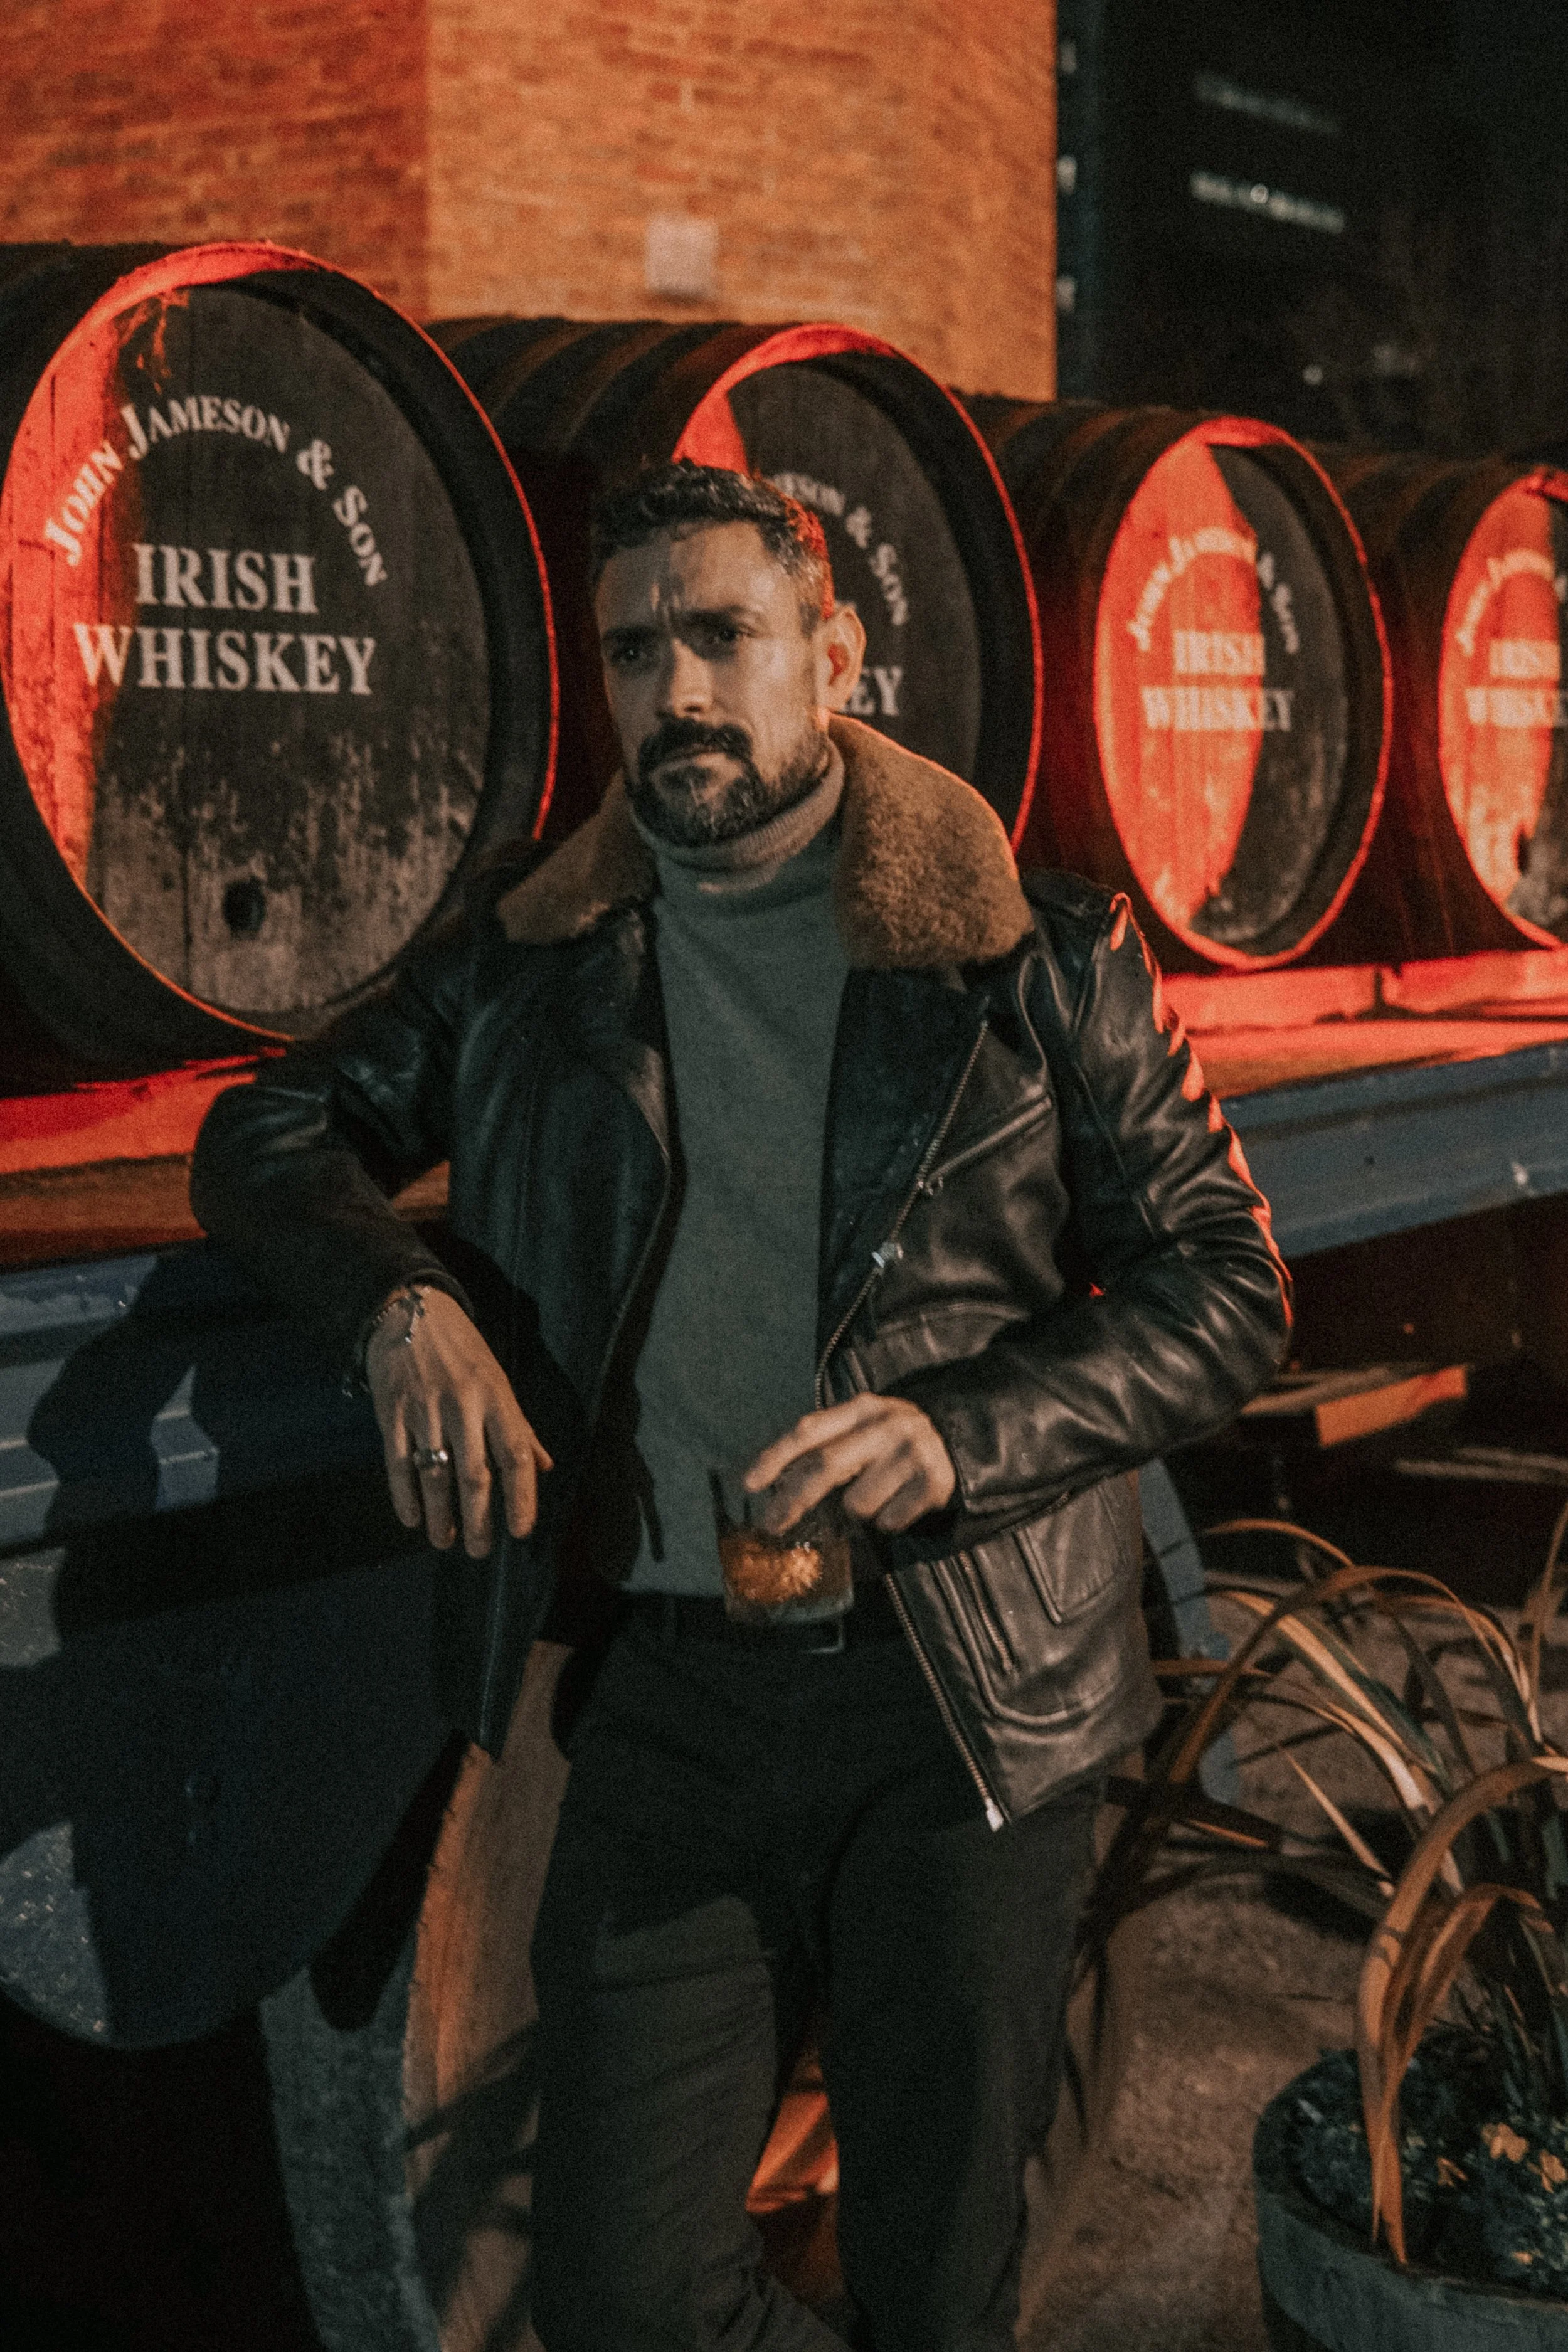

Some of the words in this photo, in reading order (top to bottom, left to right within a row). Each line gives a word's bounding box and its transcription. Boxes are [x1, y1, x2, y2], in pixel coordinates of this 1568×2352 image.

[44, 440, 124, 566] JOHN
[121, 395, 290, 460] JAMESON
[297, 439, 334, 490] &
[332, 485, 388, 586] SON
[134, 544, 317, 613] IRISH
[73, 623, 376, 695] WHISKEY
